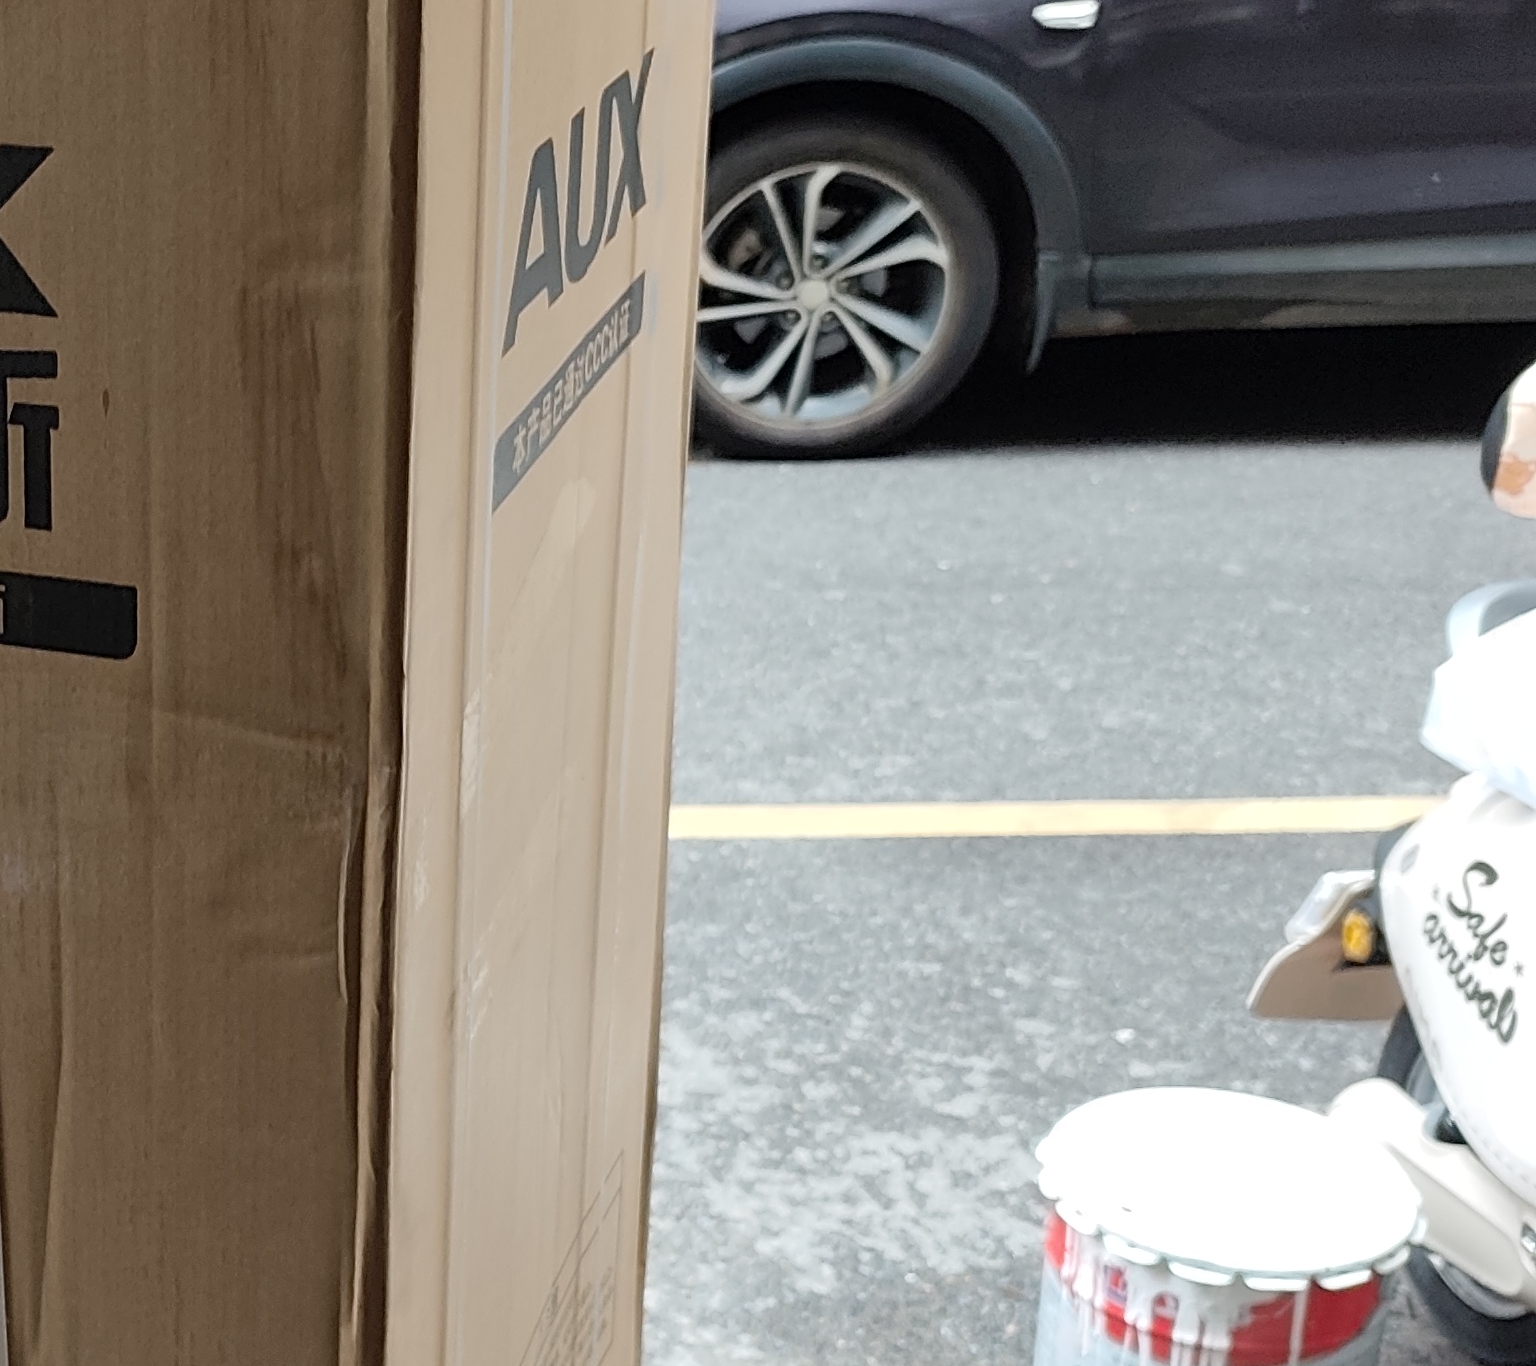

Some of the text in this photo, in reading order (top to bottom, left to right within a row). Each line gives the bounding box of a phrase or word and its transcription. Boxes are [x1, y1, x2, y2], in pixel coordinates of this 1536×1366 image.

[501, 47, 655, 358] AUX
[511, 298, 632, 475] 本产品已通过CCC认证
[1423, 913, 1518, 1044] arrival
[1446, 860, 1508, 966] Safe
